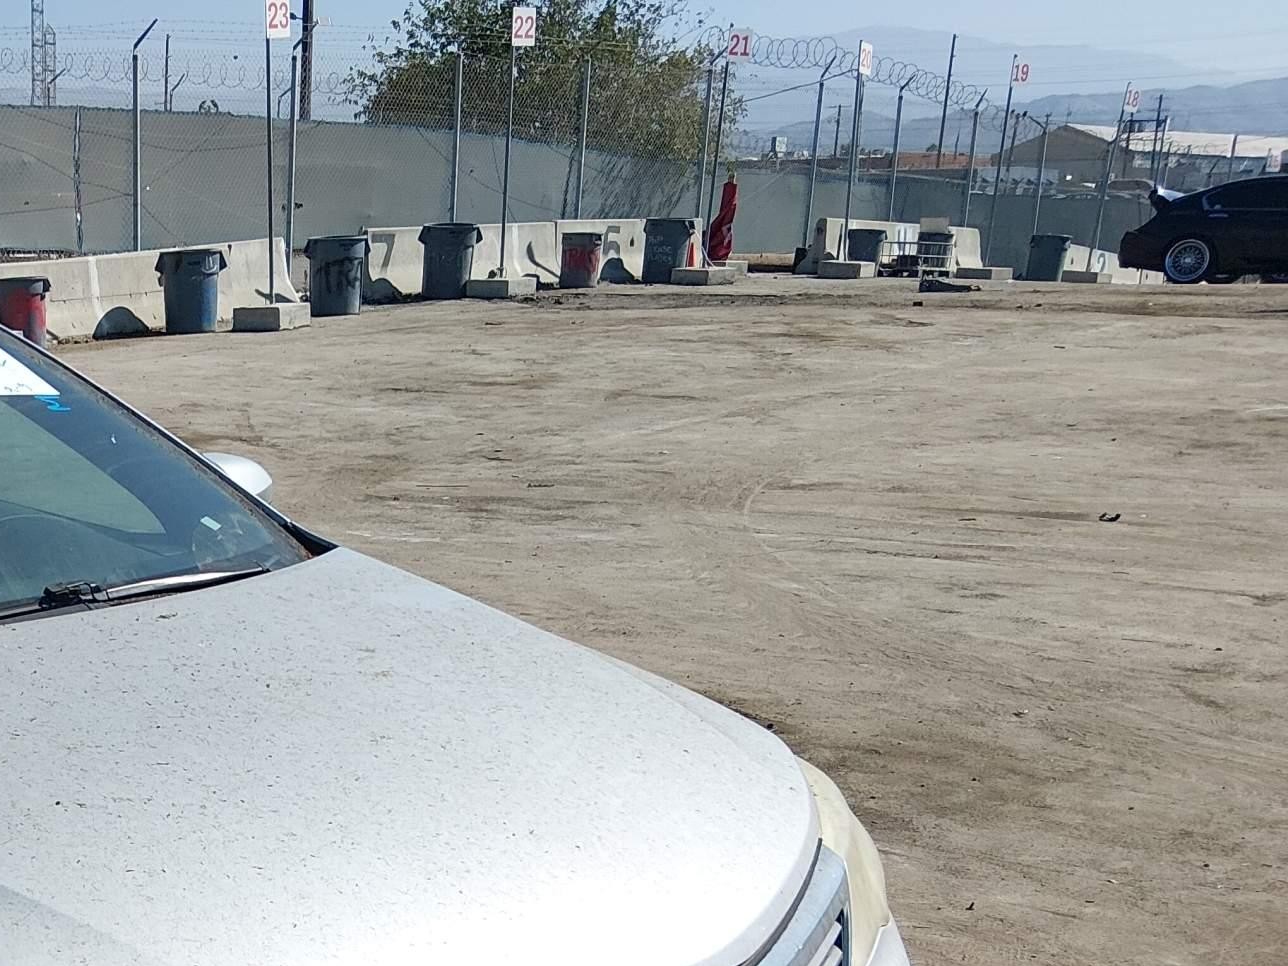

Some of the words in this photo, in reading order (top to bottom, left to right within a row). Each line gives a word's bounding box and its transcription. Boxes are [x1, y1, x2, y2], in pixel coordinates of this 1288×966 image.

[268, 2, 289, 29] 23
[514, 15, 534, 39] 22
[728, 34, 749, 56] 21
[861, 48, 872, 69] 20
[1013, 64, 1029, 81] 19
[1126, 90, 1139, 107] 18
